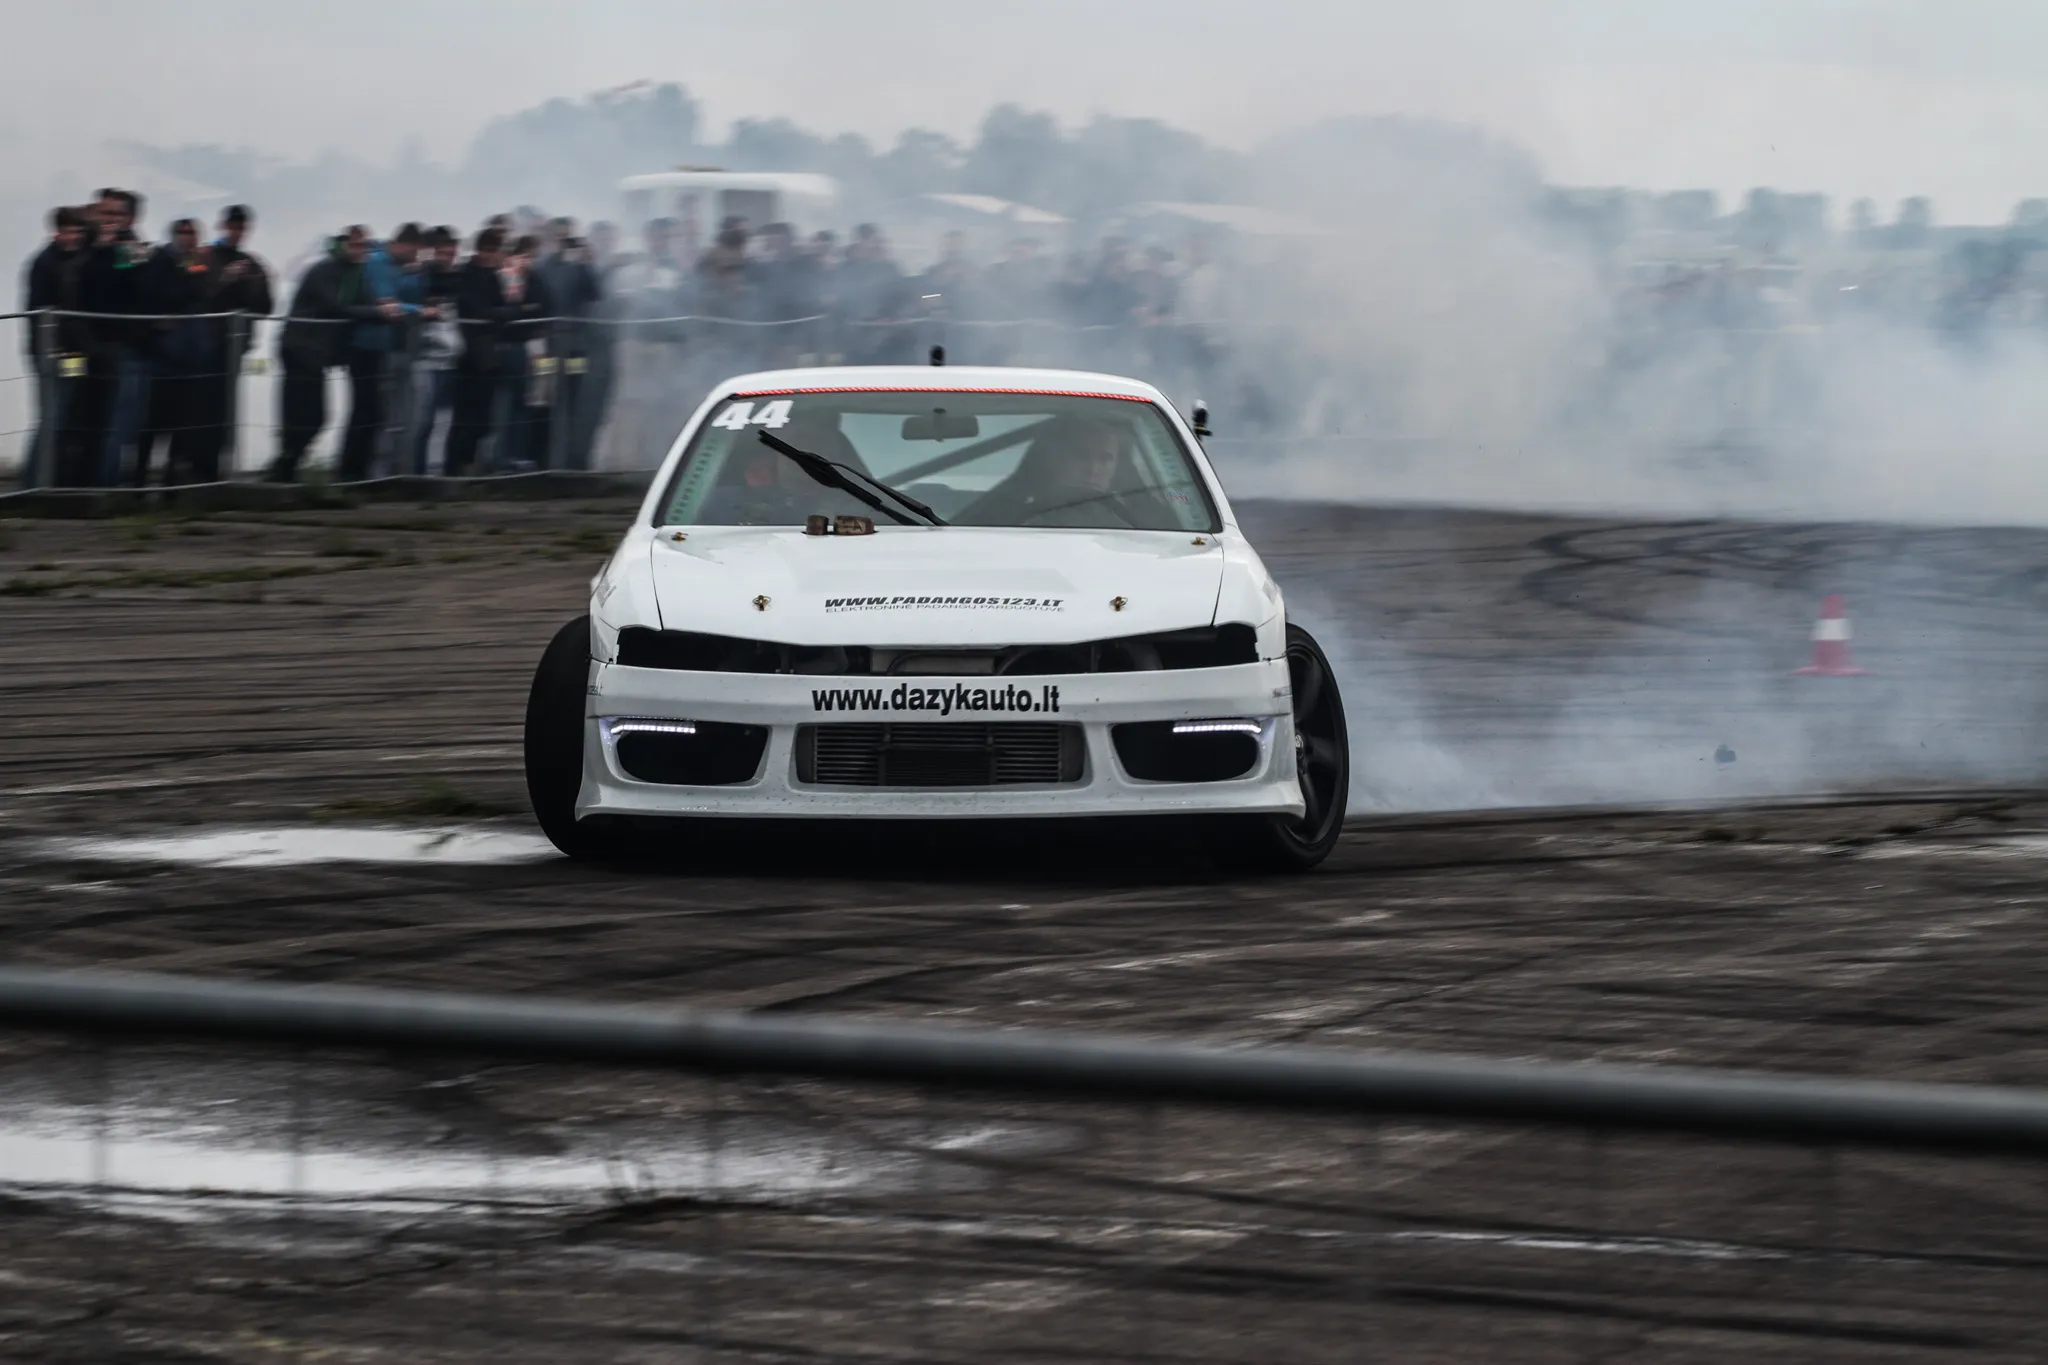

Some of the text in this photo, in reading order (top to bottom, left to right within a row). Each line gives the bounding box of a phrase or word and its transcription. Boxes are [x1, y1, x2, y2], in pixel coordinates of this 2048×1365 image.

[711, 400, 794, 430] 44
[825, 596, 1064, 608] WWW.PADANGOS123.LT
[811, 683, 1060, 716] www.dazykauto.lt
